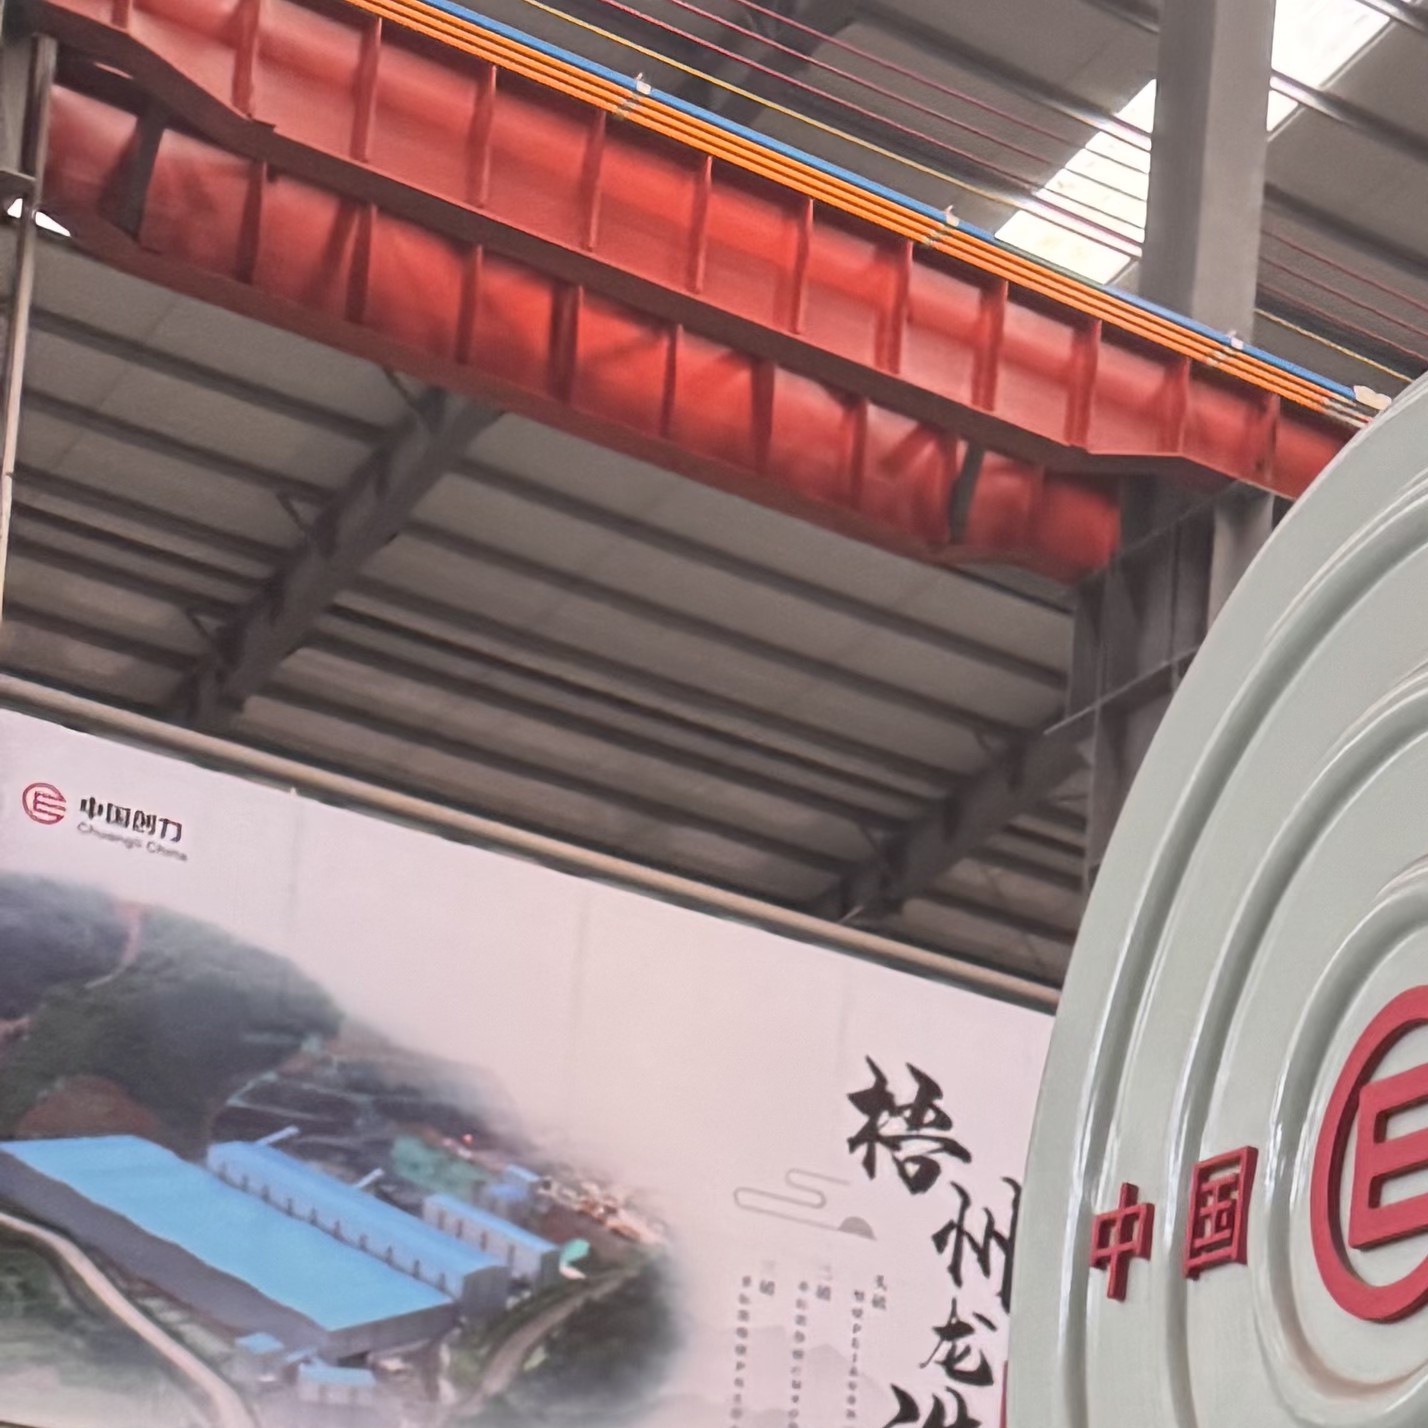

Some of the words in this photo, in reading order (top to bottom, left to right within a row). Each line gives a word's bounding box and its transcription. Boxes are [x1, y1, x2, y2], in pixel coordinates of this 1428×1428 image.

[79, 797, 183, 843] 中国创力
[1090, 1145, 1259, 1302] 中国
